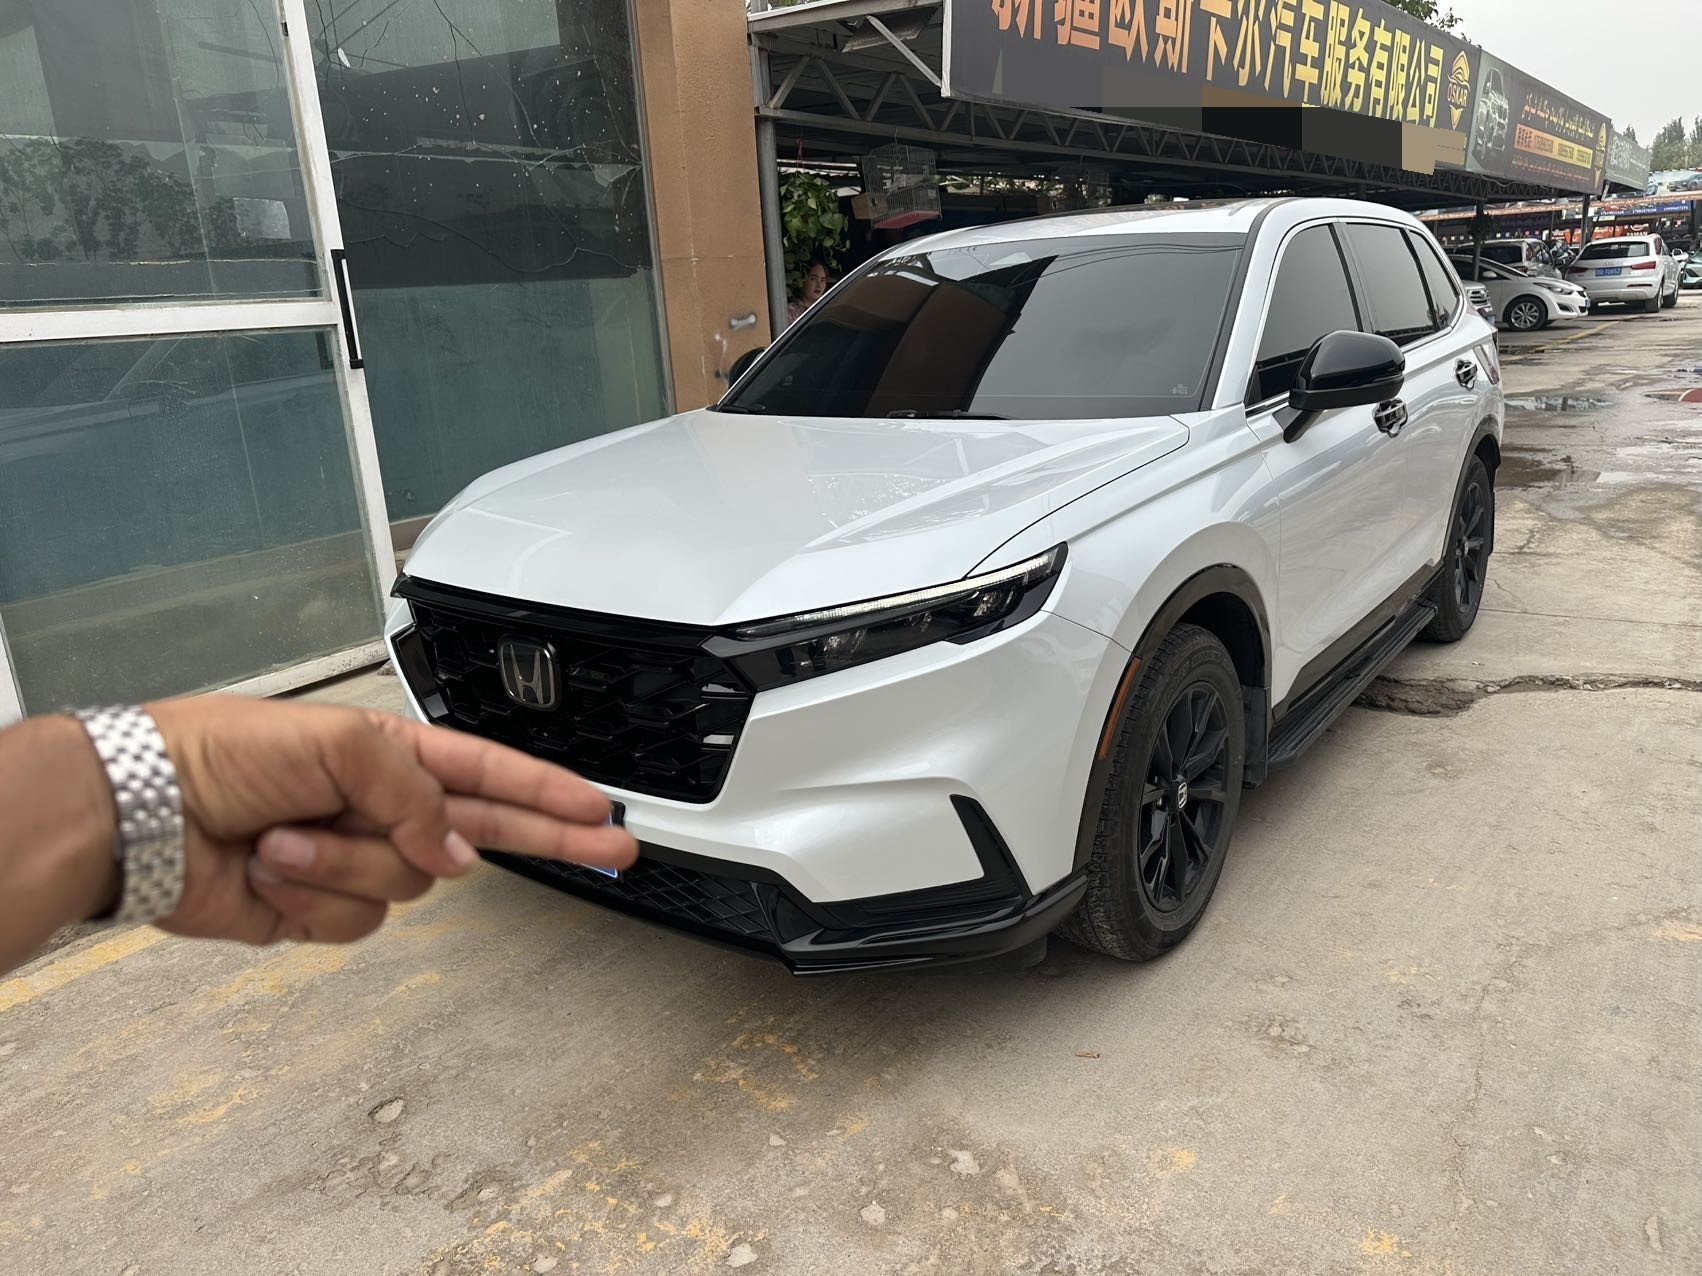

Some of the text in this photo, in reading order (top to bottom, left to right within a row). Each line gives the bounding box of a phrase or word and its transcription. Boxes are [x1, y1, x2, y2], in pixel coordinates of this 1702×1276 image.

[992, 0, 1443, 128] 斯卡尔汽车服务有限公司
[1447, 83, 1468, 107] OSKAR
